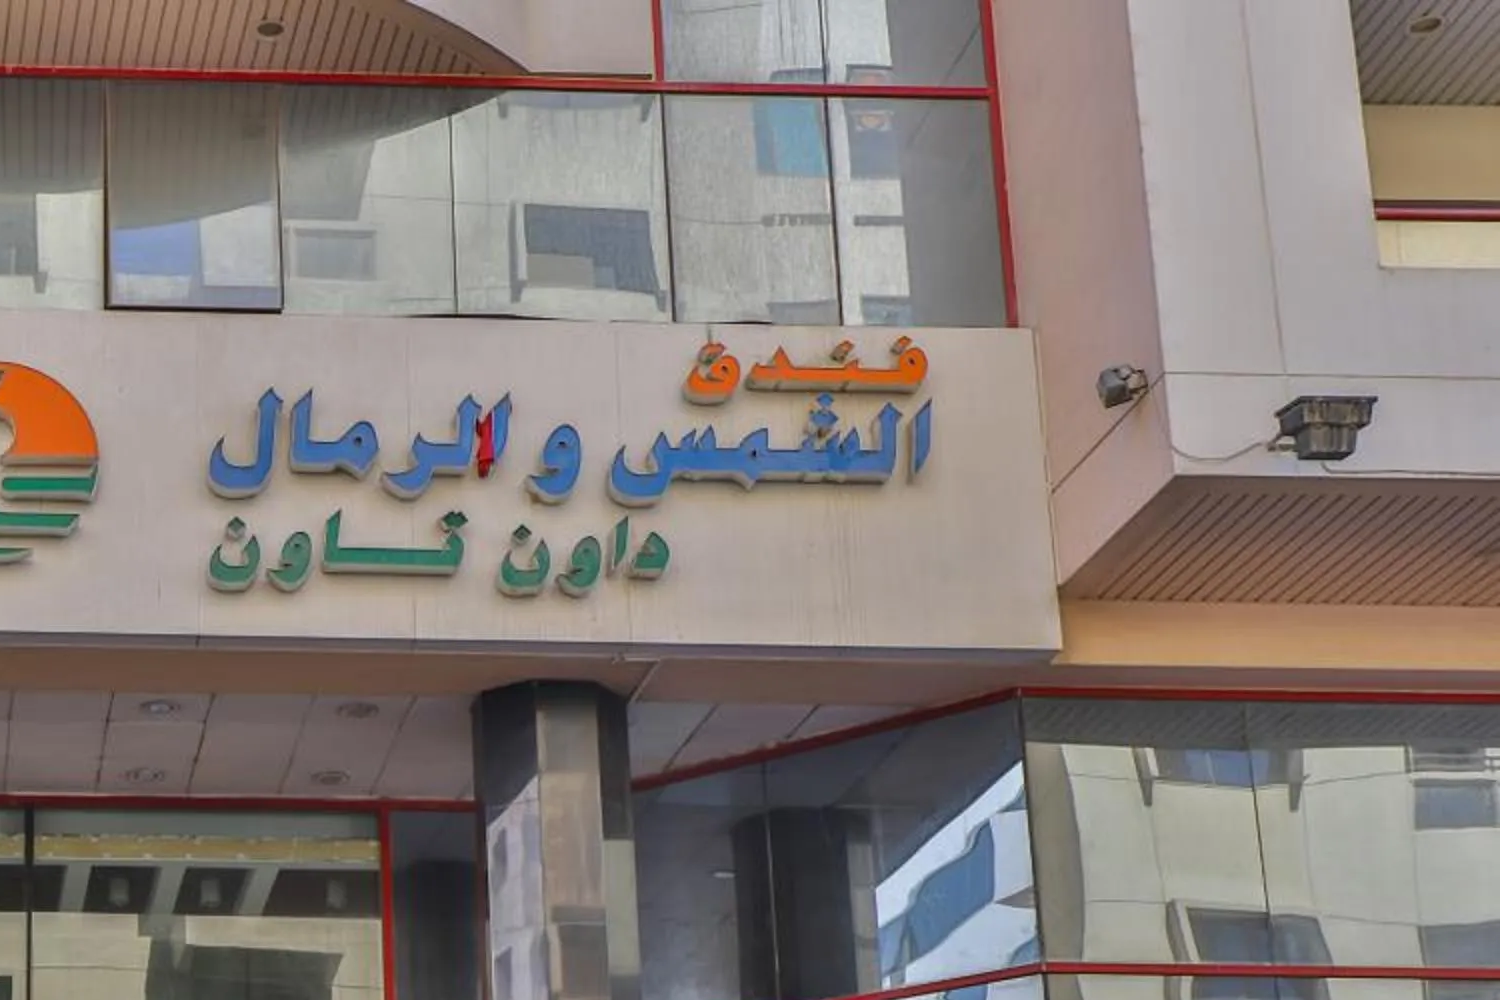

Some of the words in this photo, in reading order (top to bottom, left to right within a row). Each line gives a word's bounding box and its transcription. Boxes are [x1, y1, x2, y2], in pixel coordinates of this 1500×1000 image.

[683, 335, 928, 405] فندق
[206, 386, 512, 501] الرمال
[607, 393, 932, 507] الشمس
[207, 509, 468, 593] تاون
[497, 515, 670, 598] داون
